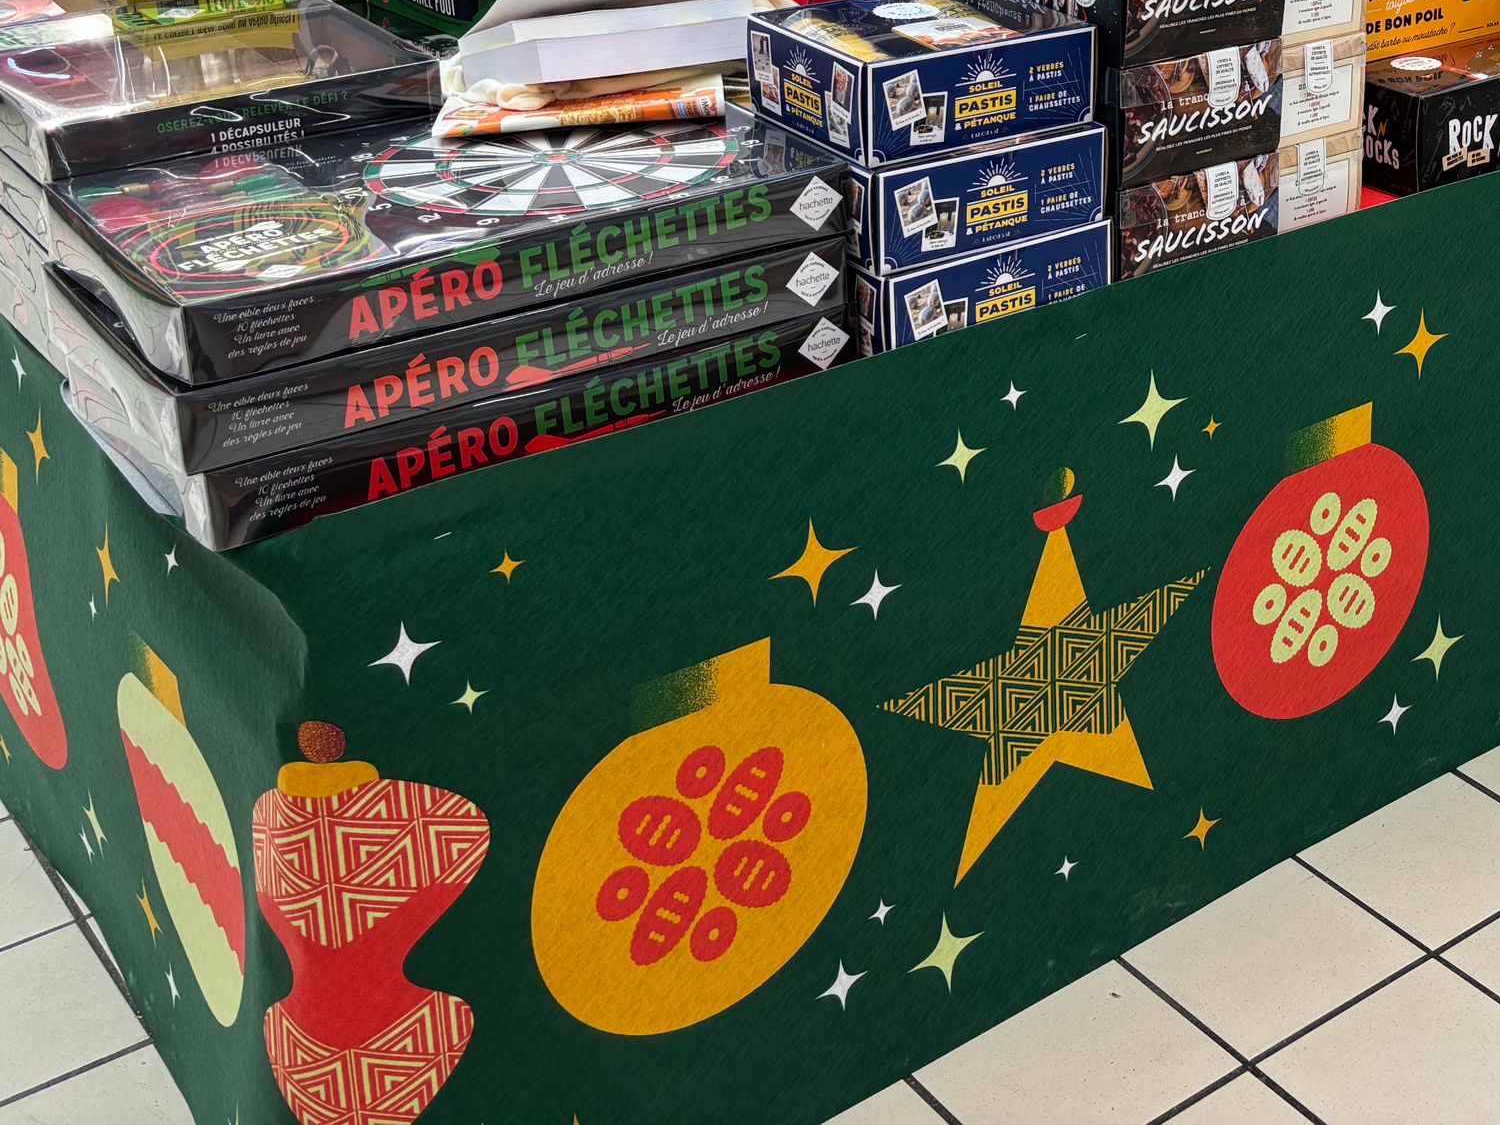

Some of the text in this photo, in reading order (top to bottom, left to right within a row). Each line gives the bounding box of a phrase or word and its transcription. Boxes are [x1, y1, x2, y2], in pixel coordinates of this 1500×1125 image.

[1386, 7, 1444, 31] BON POIL
[969, 80, 1003, 93] SOLEIL
[958, 93, 1015, 116] PASTIS
[219, 118, 301, 142] DÉCAPSULEUR
[963, 111, 1017, 129] PÉTANQUE
[1138, 94, 1273, 145] SAUCISSON
[1448, 113, 1498, 156] ROCK
[980, 184, 1015, 198] SOLEIL
[799, 195, 834, 212] hachette
[970, 197, 1026, 219] PASTIS
[975, 214, 1028, 233] PÉTANQUE
[1134, 207, 1270, 263] SAUCISSON
[349, 184, 772, 340] APÉRO FLÉCHETTES
[795, 271, 830, 288] hachette
[344, 265, 769, 429] APÉRO FLÉCHETTES
[807, 337, 841, 353] hachette
[367, 331, 781, 501] APÉRO FLÉCHETTES
